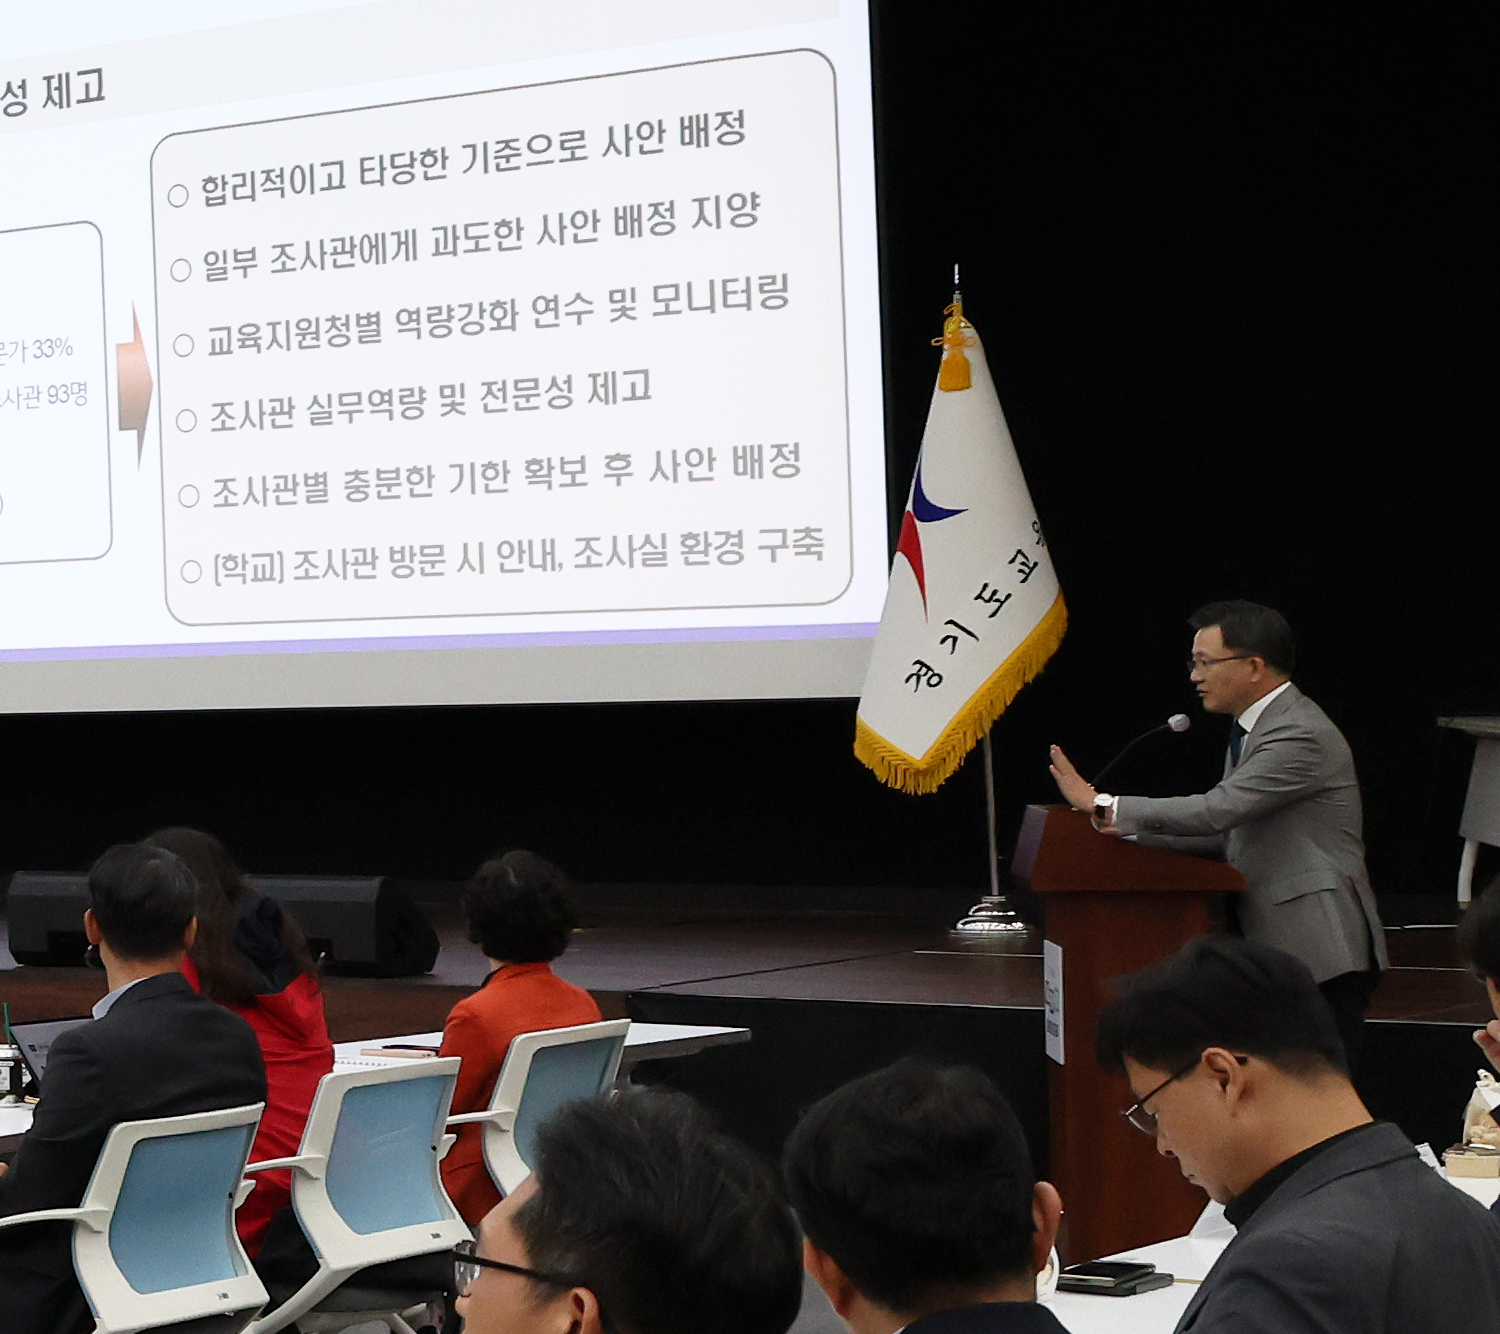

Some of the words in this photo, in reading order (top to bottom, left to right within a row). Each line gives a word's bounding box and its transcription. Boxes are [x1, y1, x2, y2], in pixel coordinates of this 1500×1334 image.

[43, 67, 106, 111] 제고
[200, 159, 346, 208] 합리적이고
[359, 146, 448, 187] 타당한
[462, 131, 587, 174] 기준으로
[602, 119, 666, 159] 사안
[679, 109, 746, 149] 배정
[204, 246, 257, 282] 일부
[270, 229, 418, 275] 조사관에게
[431, 218, 524, 258] 과도한
[536, 208, 600, 249] 사안
[614, 198, 676, 240] 배정
[691, 191, 761, 231] 지양
[207, 311, 383, 358] 교육지원청별
[396, 298, 519, 342] 역량강화
[532, 292, 594, 330] 연수
[609, 287, 638, 322] 및
[652, 273, 789, 316] 모니터링
[33, 337, 73, 359] 33%
[48, 381, 88, 406] 93명
[210, 398, 295, 433] 조사관
[307, 384, 427, 425] 실무역량
[438, 382, 466, 417] 및
[480, 373, 574, 415] 전문성
[587, 369, 652, 406] 제고
[212, 471, 330, 508] 조사관별
[342, 466, 435, 503] 충분한
[448, 459, 510, 496] 기한
[524, 455, 587, 490] 확보
[604, 453, 633, 486] 후
[649, 447, 716, 483] 사안
[732, 443, 801, 480] 배정
[294, 548, 378, 581] 조사관
[389, 545, 446, 578] 방문
[457, 542, 484, 575] 시
[496, 539, 563, 573] 안내,
[573, 533, 668, 568] 조사실
[680, 529, 744, 565] 환경
[757, 526, 824, 561] 구축
